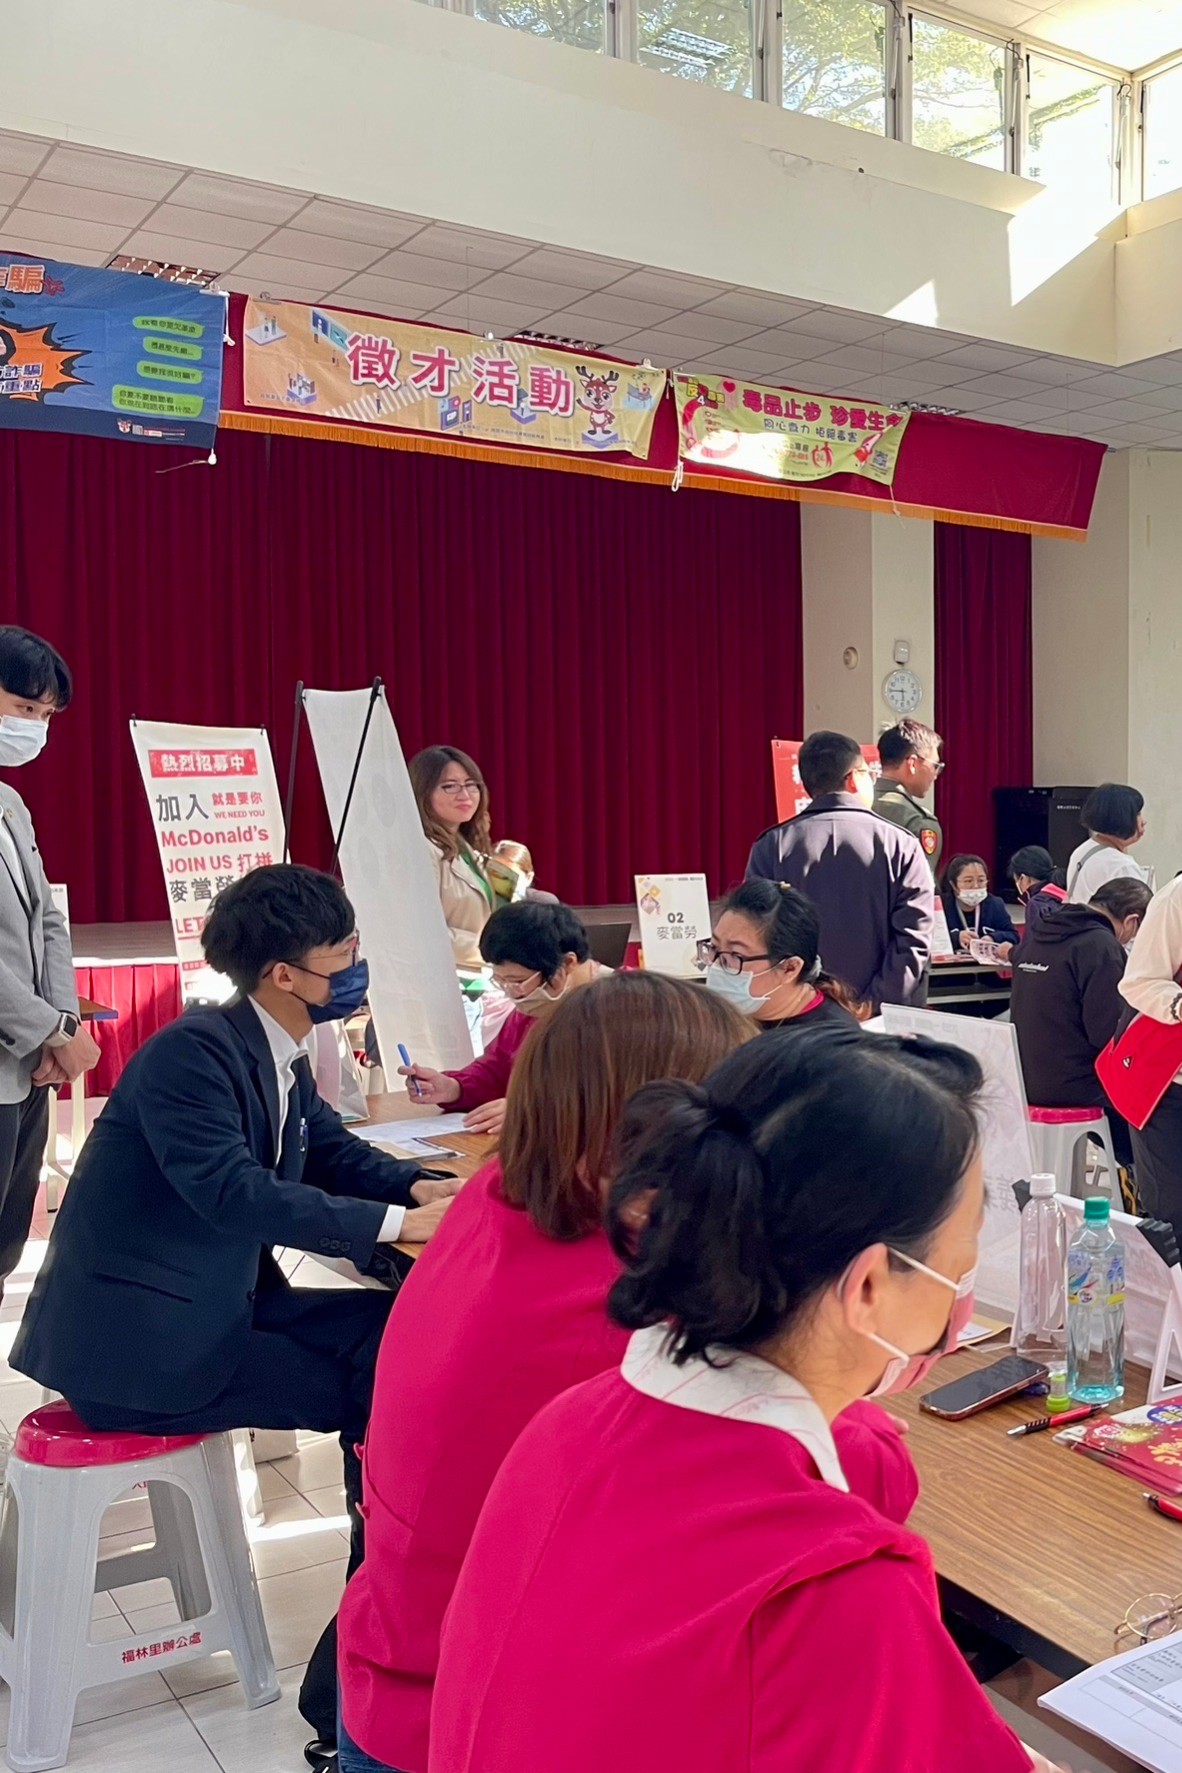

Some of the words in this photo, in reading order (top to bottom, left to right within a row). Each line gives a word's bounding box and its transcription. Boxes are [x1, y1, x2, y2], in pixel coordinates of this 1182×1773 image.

[0, 363, 42, 379] 詐騙
[345, 332, 576, 418] 徵才活動
[743, 389, 822, 422] 毒品止步
[830, 405, 904, 432] 珍愛生命
[161, 753, 245, 772] 熱烈招募中
[156, 793, 209, 822] 加入
[212, 791, 263, 807] 就是要你
[214, 811, 226, 819] WE
[227, 810, 247, 819] NEED
[249, 810, 265, 818] YOU
[166, 856, 207, 874] JOIN
[210, 854, 232, 871] US
[175, 916, 207, 934] LET
[667, 912, 684, 923] 02
[656, 926, 697, 940] 麥當勞
[121, 1632, 202, 1663] 福林里辦公處
